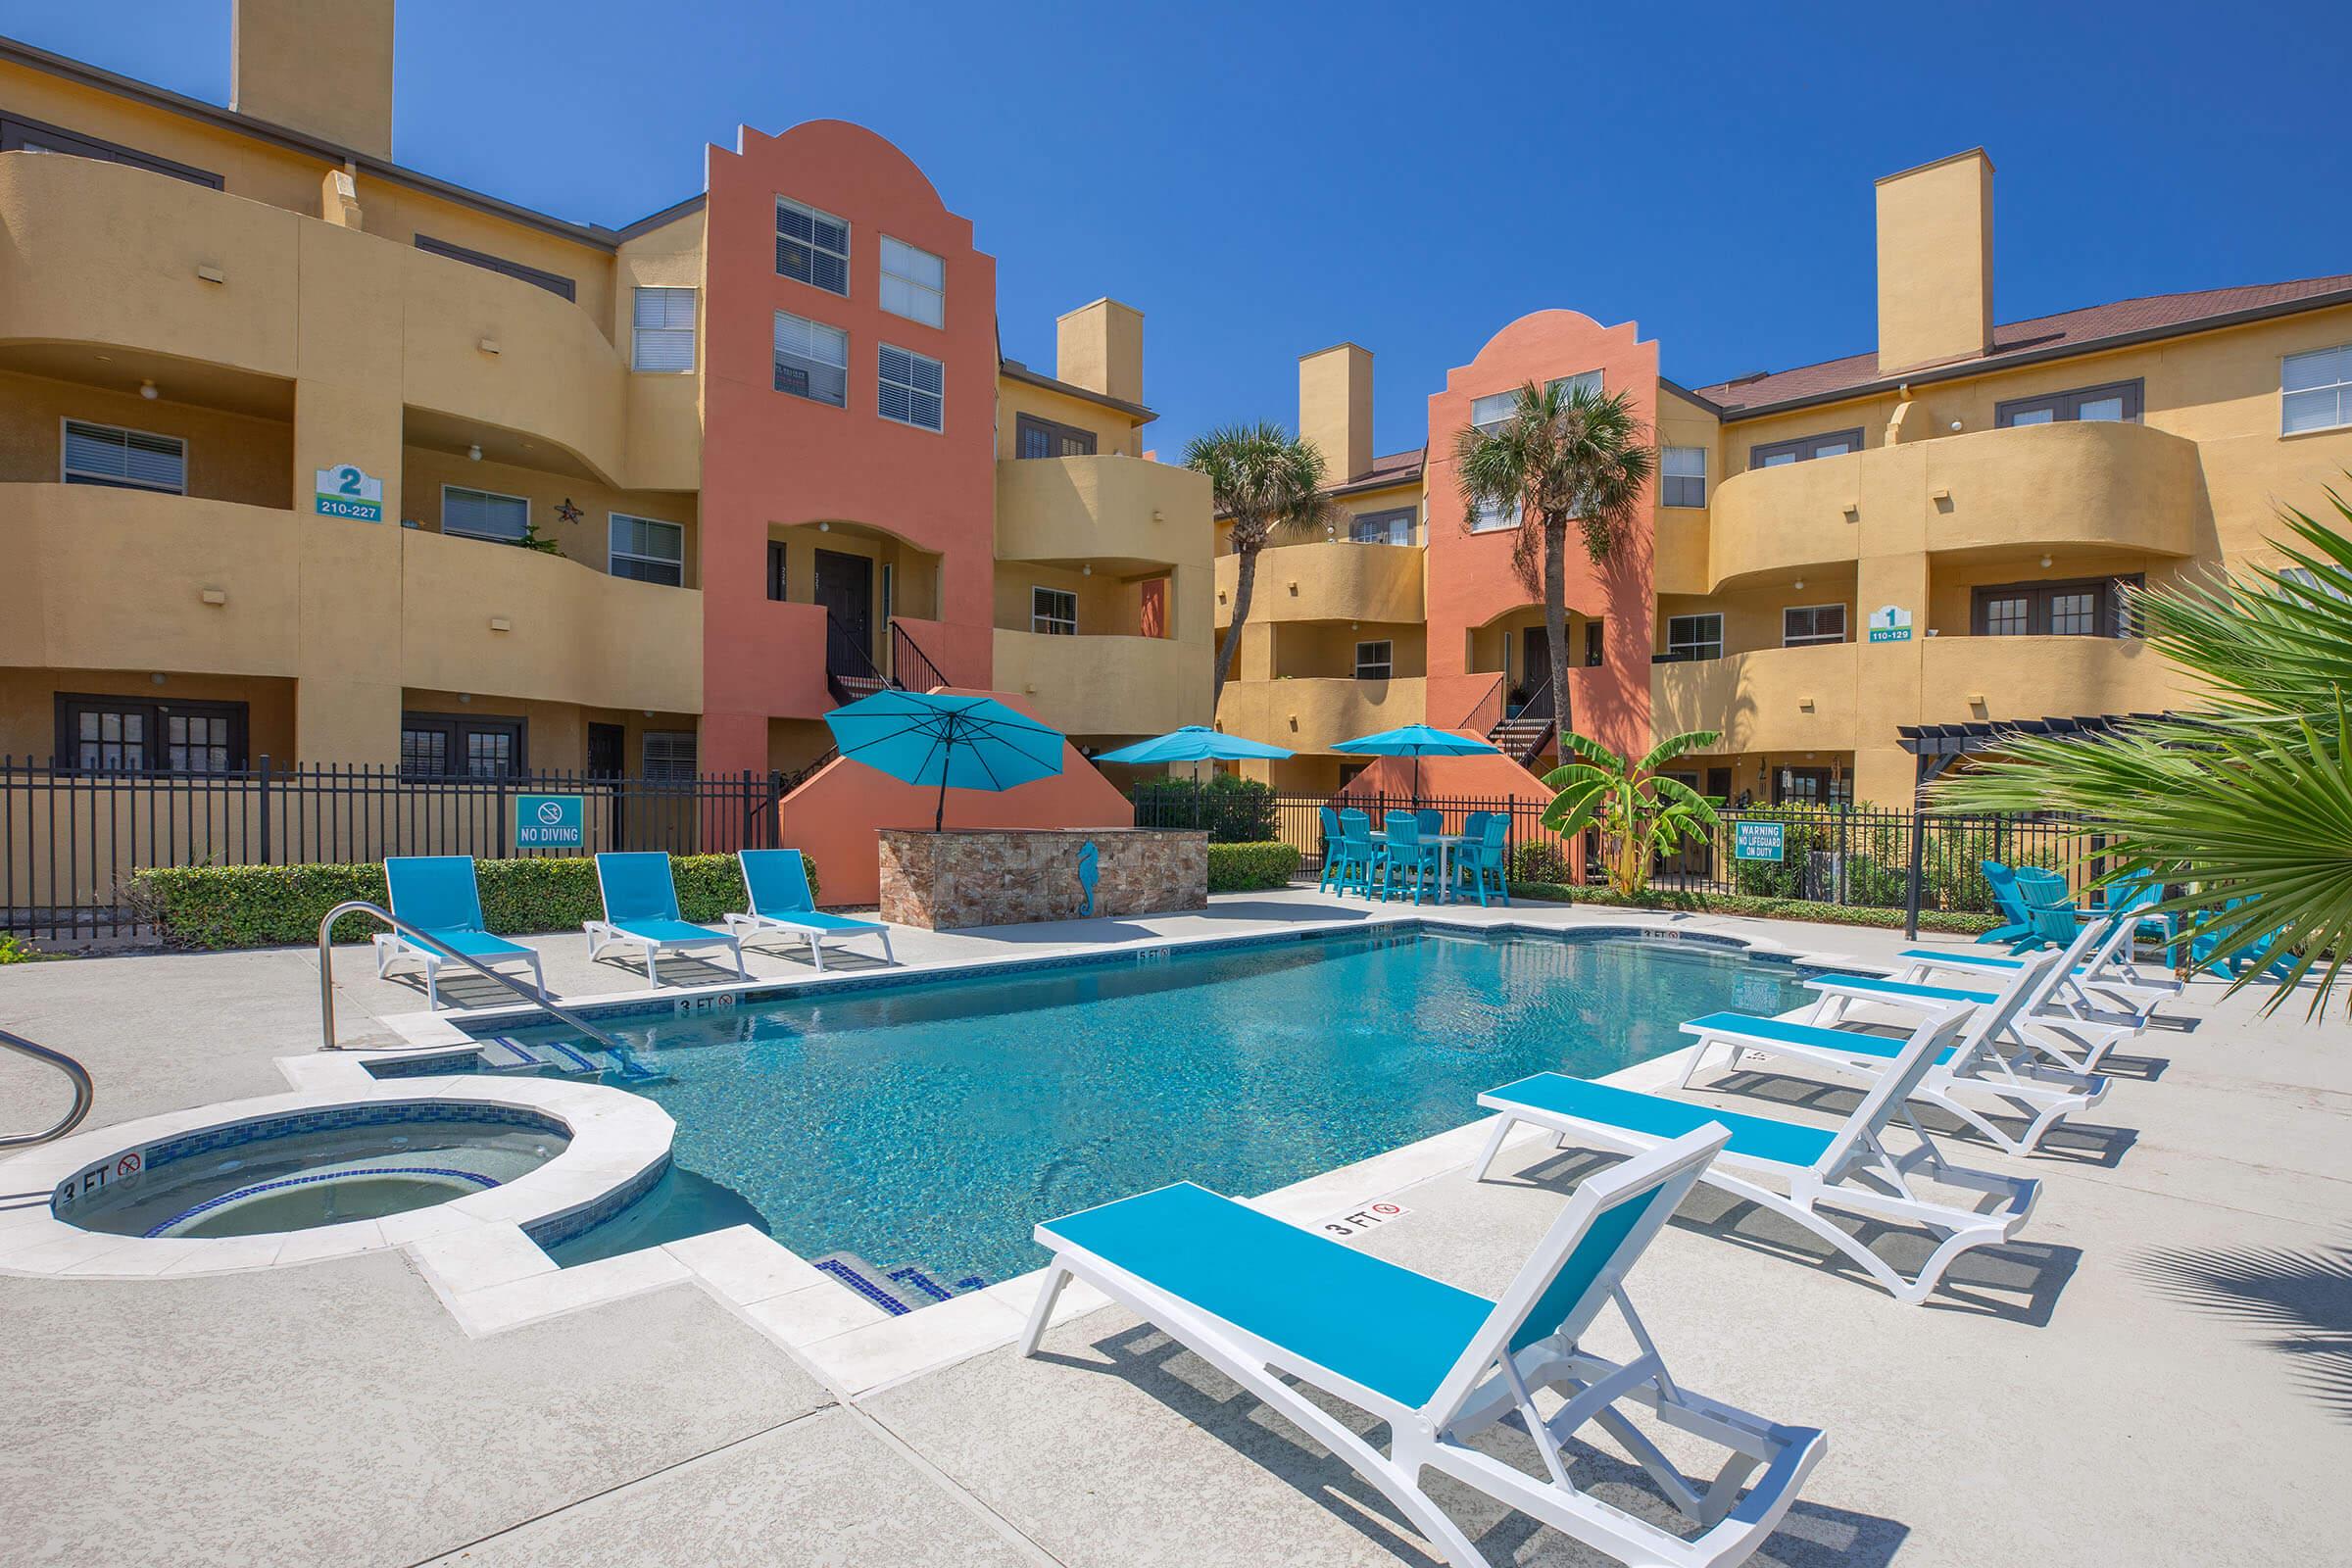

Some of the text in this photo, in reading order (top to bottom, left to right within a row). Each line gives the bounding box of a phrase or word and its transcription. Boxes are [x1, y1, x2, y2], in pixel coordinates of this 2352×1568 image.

[339, 467, 362, 496] 2
[321, 501, 376, 518] 210-227
[1885, 609, 1895, 626] 1
[1873, 630, 1908, 640] 110-129
[520, 827, 578, 842] NO DIVING
[1740, 825, 1779, 836] WARNING
[1739, 836, 1782, 848] NO LIFEGUARD
[1746, 846, 1772, 858] ON DUTY
[680, 997, 714, 1010] 3 FT
[63, 1164, 110, 1204] 3 FT
[1325, 1223, 1353, 1235] 3
[1344, 1210, 1383, 1229] FT
